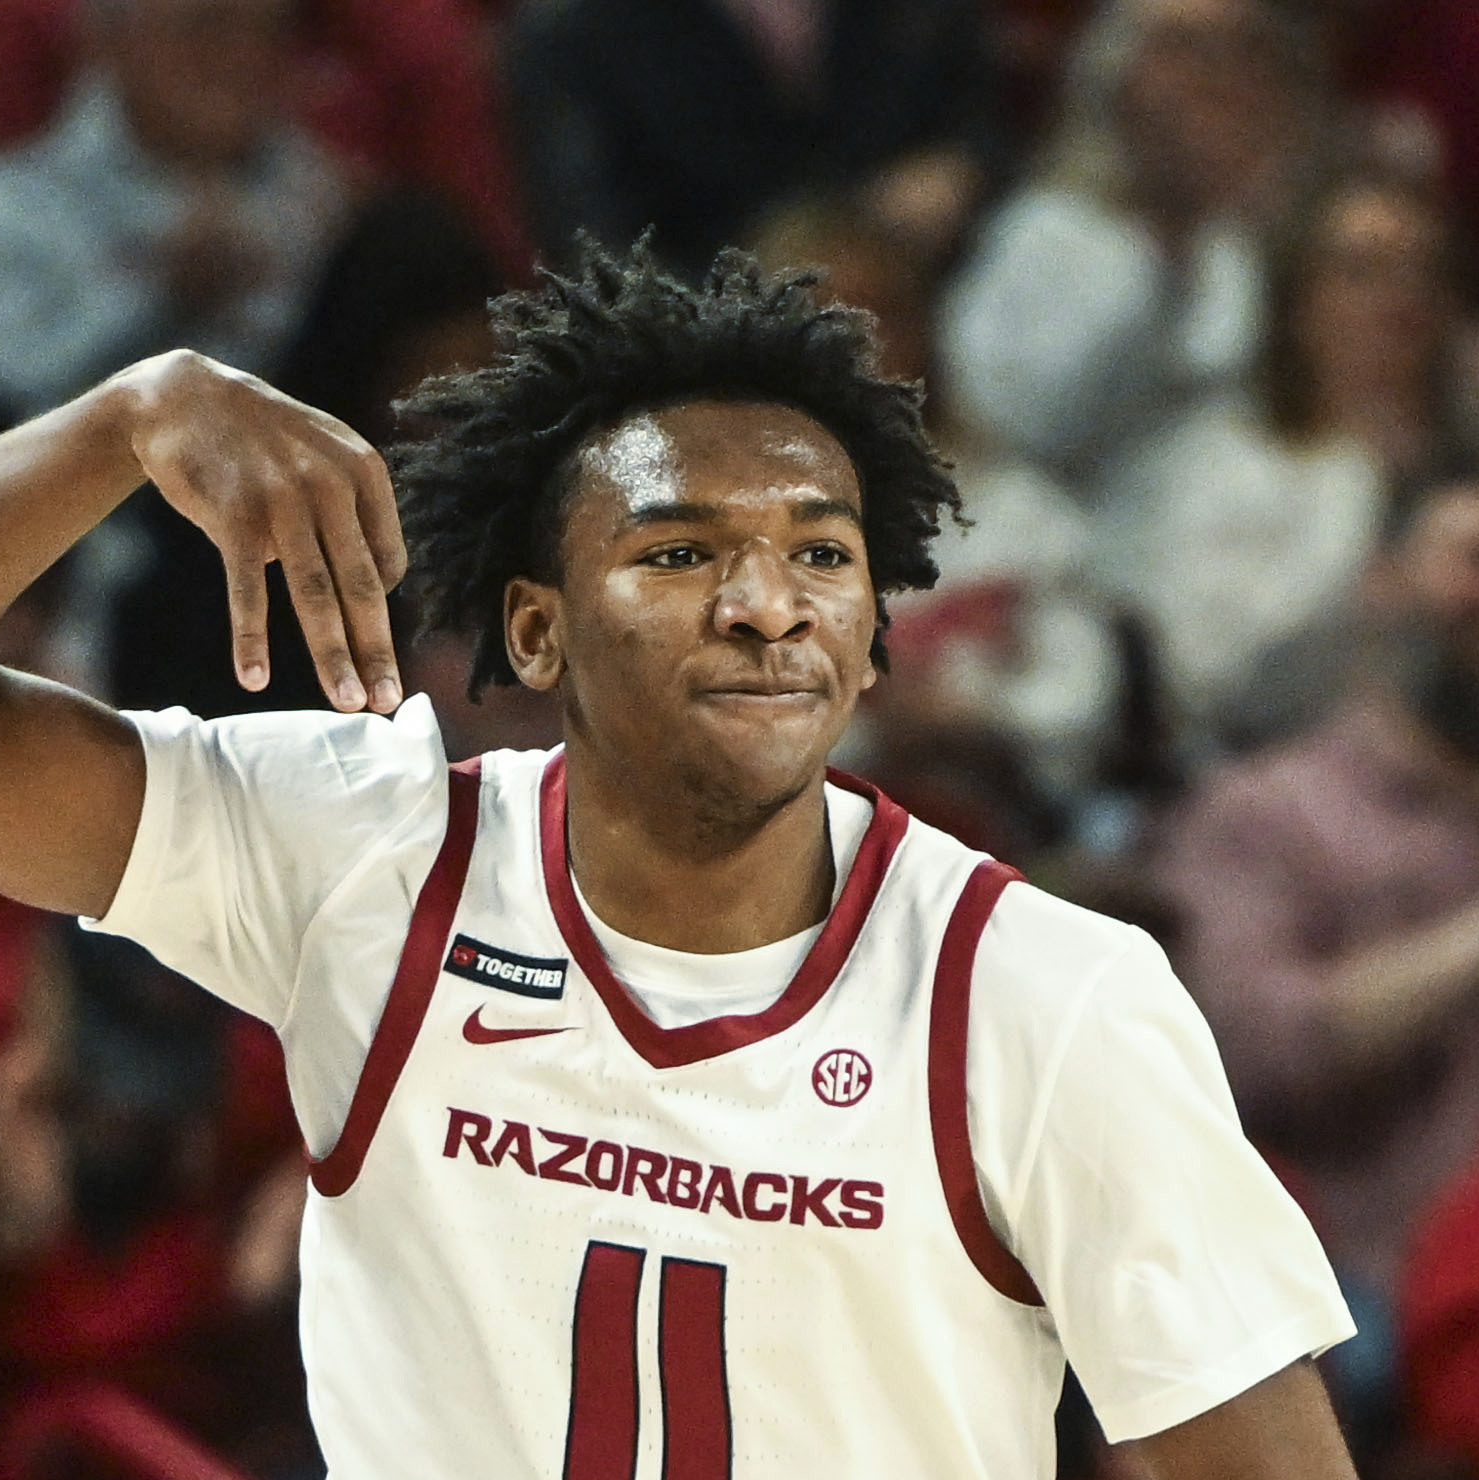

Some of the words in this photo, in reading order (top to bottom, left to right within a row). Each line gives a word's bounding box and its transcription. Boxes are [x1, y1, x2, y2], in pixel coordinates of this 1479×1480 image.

[476, 953, 563, 988] TOGETHER
[818, 1052, 869, 1103] SEC
[442, 1106, 885, 1230] RAZORBACKS
